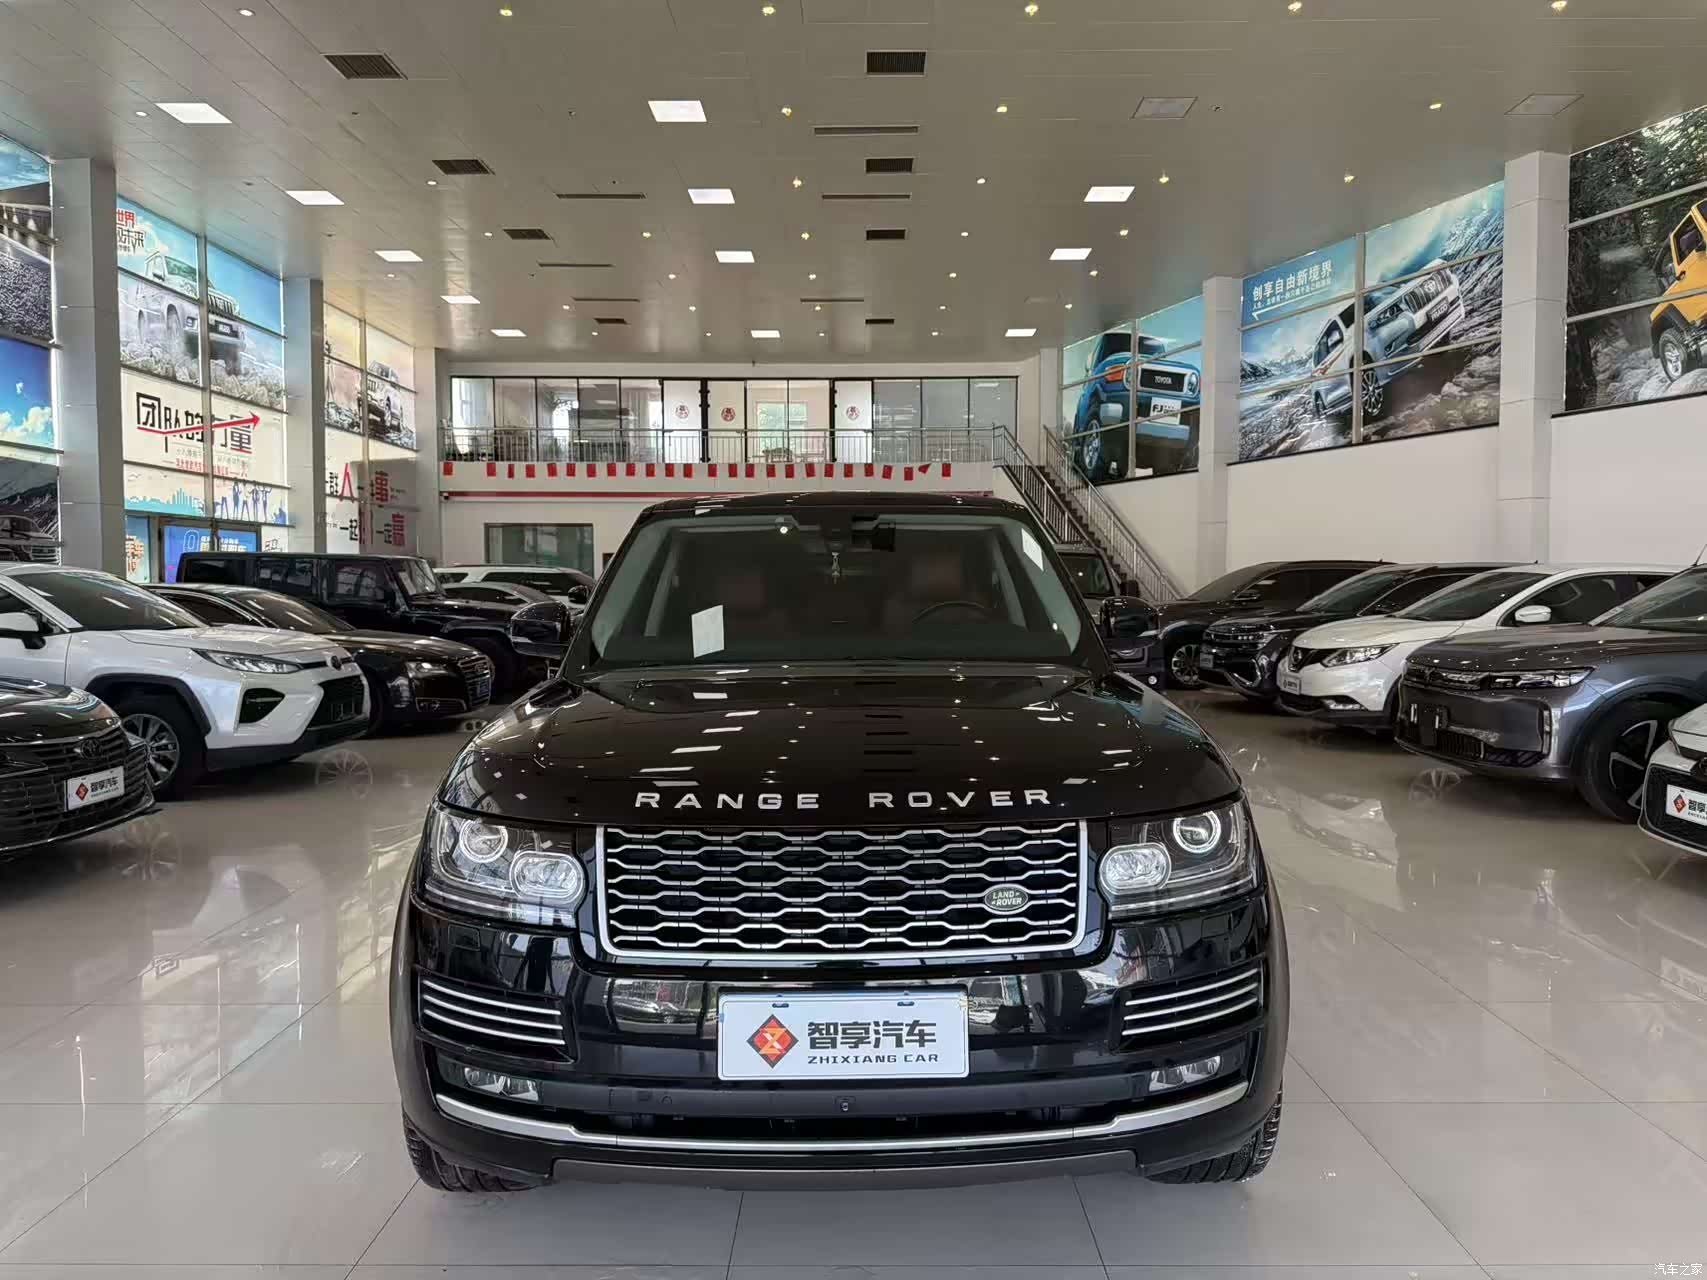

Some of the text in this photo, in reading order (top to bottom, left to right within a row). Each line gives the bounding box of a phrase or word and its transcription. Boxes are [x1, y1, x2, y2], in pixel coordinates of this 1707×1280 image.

[1253, 260, 1332, 301] 创享自由新境界
[1154, 375, 1172, 384] TOYOTA
[1152, 404, 1163, 413] FJ
[635, 789, 1051, 809] RANGE ROVER
[993, 891, 1015, 899] LAND
[996, 897, 1022, 906] ROVER
[808, 1020, 937, 1050] 智享汽车
[808, 1053, 939, 1065] ZHIXIANG CAR
